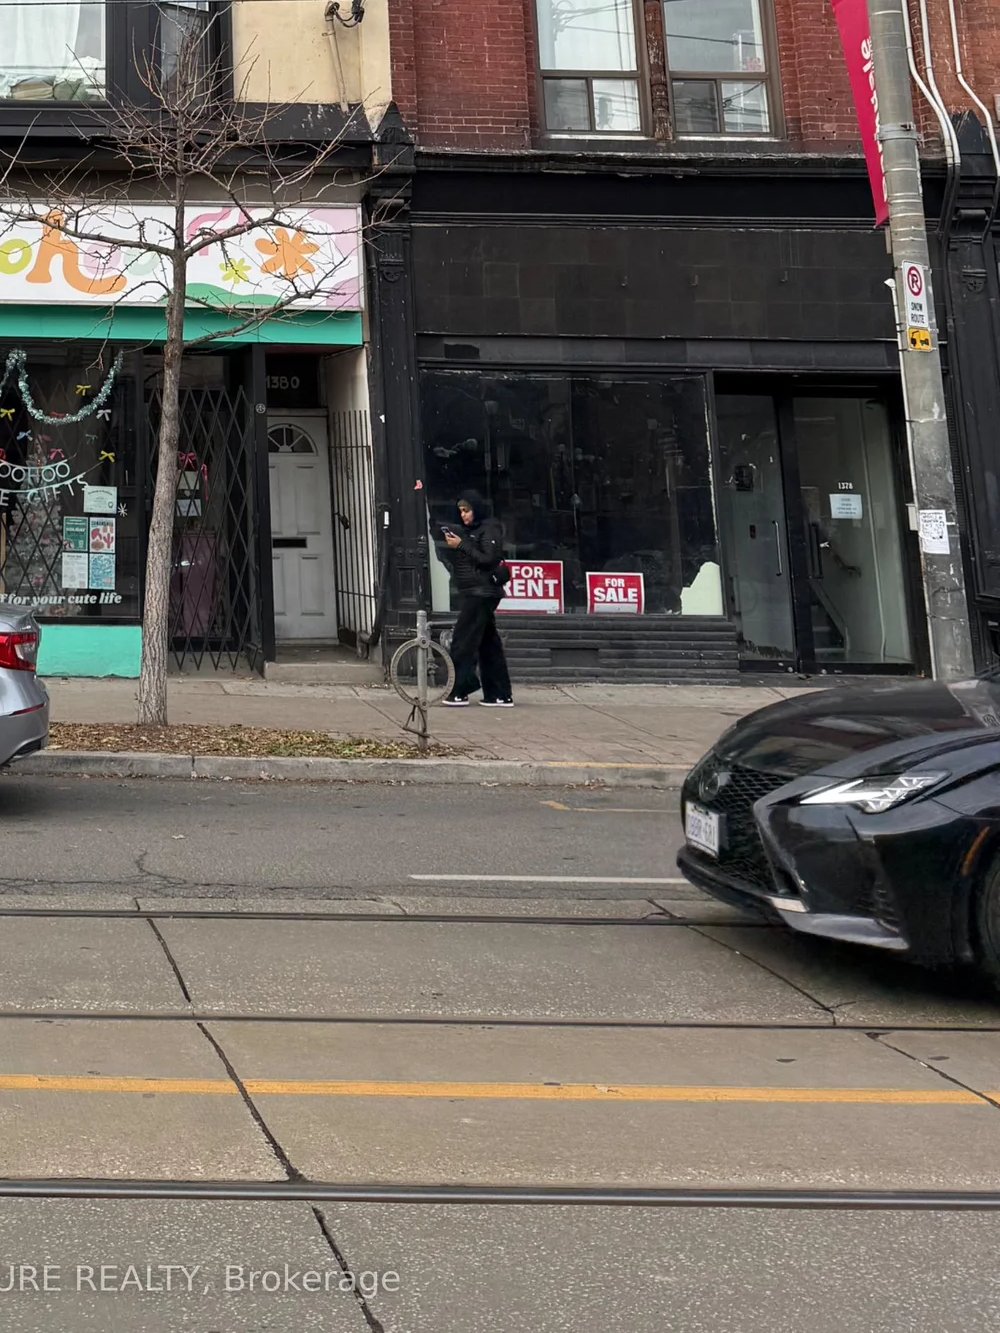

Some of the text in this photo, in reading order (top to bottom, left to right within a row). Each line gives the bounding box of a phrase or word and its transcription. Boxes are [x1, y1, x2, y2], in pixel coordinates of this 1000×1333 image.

[911, 301, 923, 312] SNOW
[910, 313, 925, 324] ROUTE
[511, 566, 544, 579] FOR
[503, 579, 558, 597] RENT
[605, 578, 625, 588] FOR
[7, 593, 31, 605] for
[31, 595, 64, 606] your
[67, 594, 97, 604] cute
[99, 592, 123, 604] life
[593, 588, 638, 602] SALE
